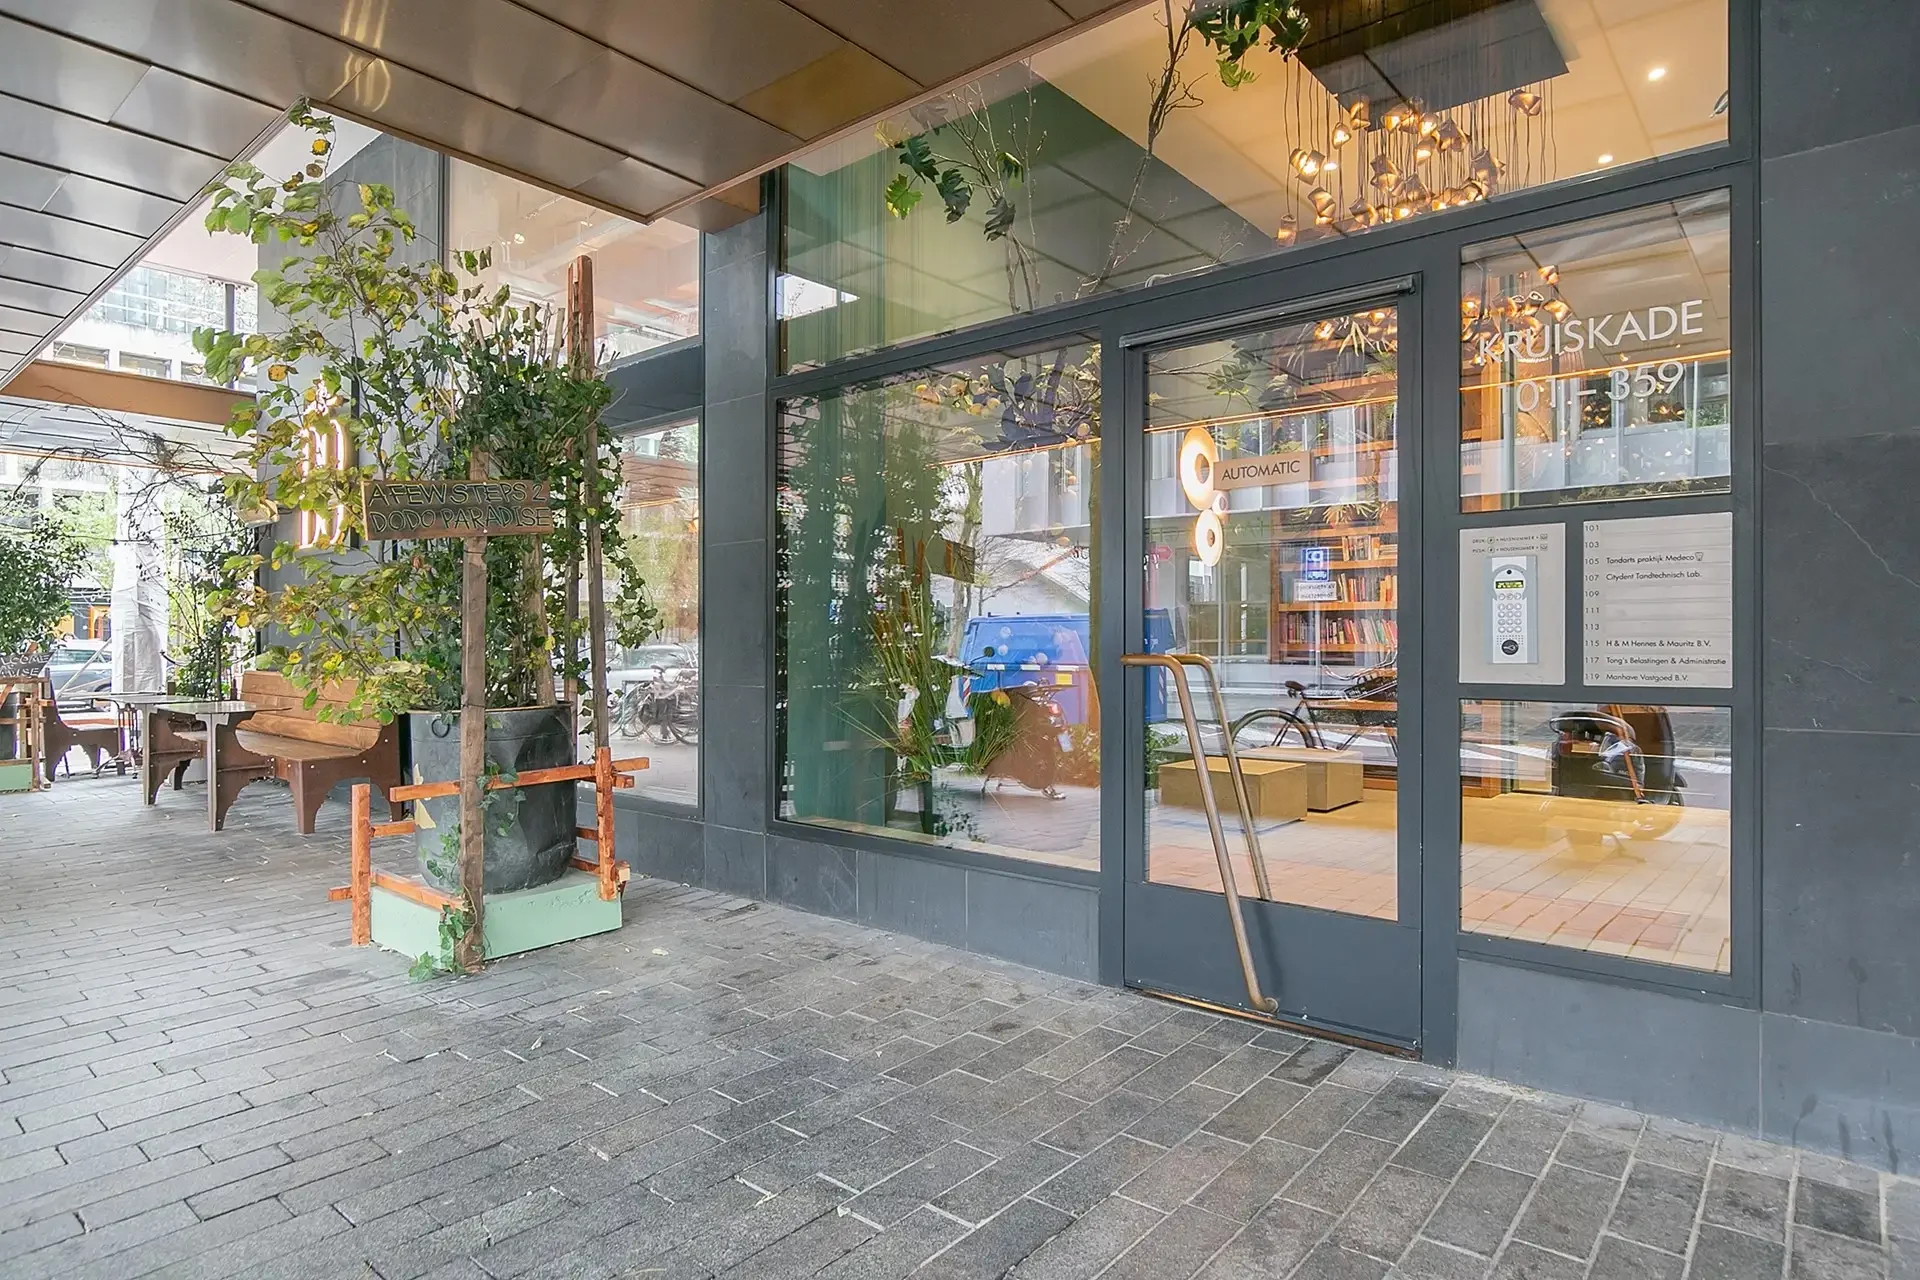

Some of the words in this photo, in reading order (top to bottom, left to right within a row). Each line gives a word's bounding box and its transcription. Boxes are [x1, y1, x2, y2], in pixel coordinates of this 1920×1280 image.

[1479, 299, 1703, 366] KRUISKADE
[1606, 360, 1684, 401] 359
[1221, 460, 1301, 481] AUTOMATIC
[387, 482, 447, 506] FEW
[450, 482, 528, 504] STEPS
[532, 484, 548, 501] 2
[369, 508, 436, 533] DODO
[440, 504, 551, 530] PARADISE
